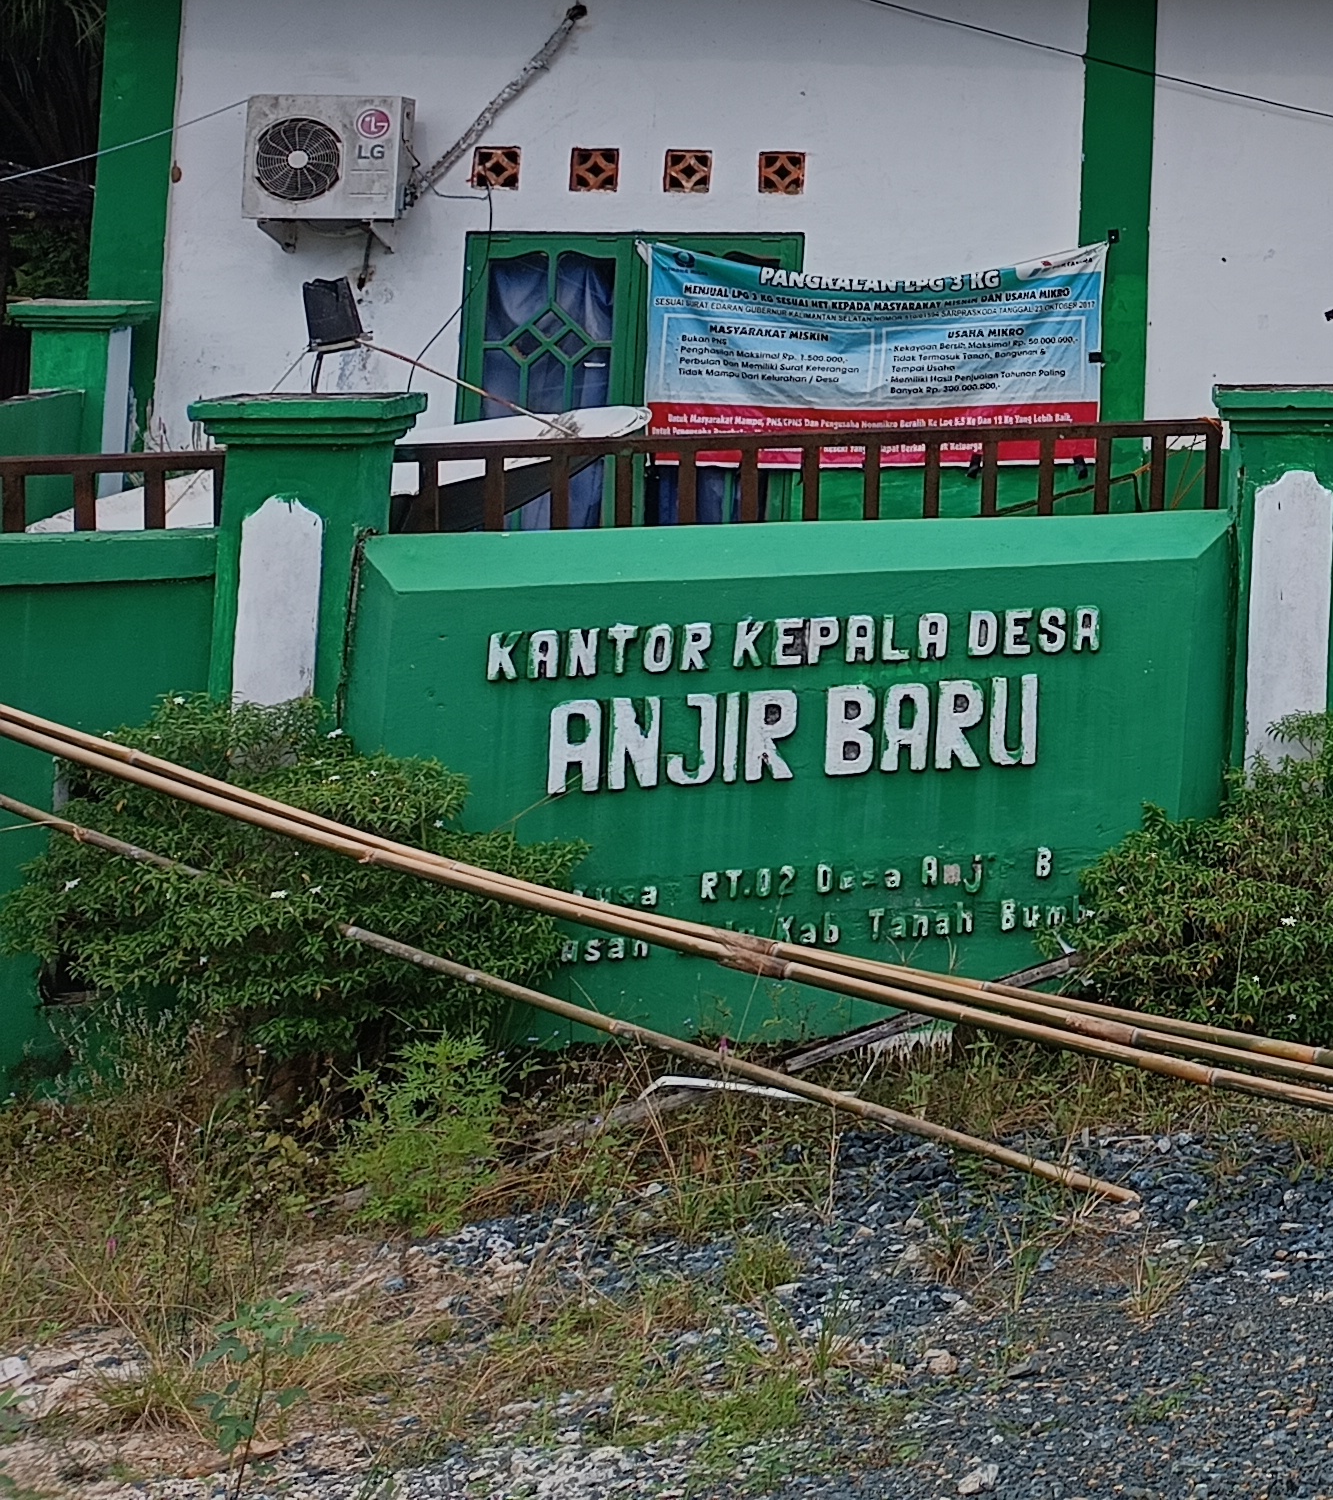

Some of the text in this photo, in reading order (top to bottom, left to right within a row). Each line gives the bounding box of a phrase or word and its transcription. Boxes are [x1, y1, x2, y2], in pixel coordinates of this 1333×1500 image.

[356, 144, 386, 160] LG
[950, 275, 965, 291] 3
[970, 270, 1001, 291] KG
[654, 297, 684, 307] SESUAI
[710, 302, 744, 313] EDARAN
[745, 304, 787, 316] GUBERNUR
[788, 308, 837, 321] KALIMANTAN
[838, 313, 873, 323] SELATAN
[683, 283, 729, 299] MENJUAL
[831, 301, 871, 312] KEPADA
[980, 292, 1003, 304] DAN
[1005, 289, 1037, 301] USAHA
[1038, 287, 1071, 299] MIKRO
[708, 324, 830, 342] MASYARAKAT MISKIN
[947, 327, 1025, 339] USAHA MIKRO
[486, 604, 1101, 682] KANTOR KEPALA DESA
[546, 672, 1039, 797] ANJIR BARU
[868, 902, 974, 941] Tanah
